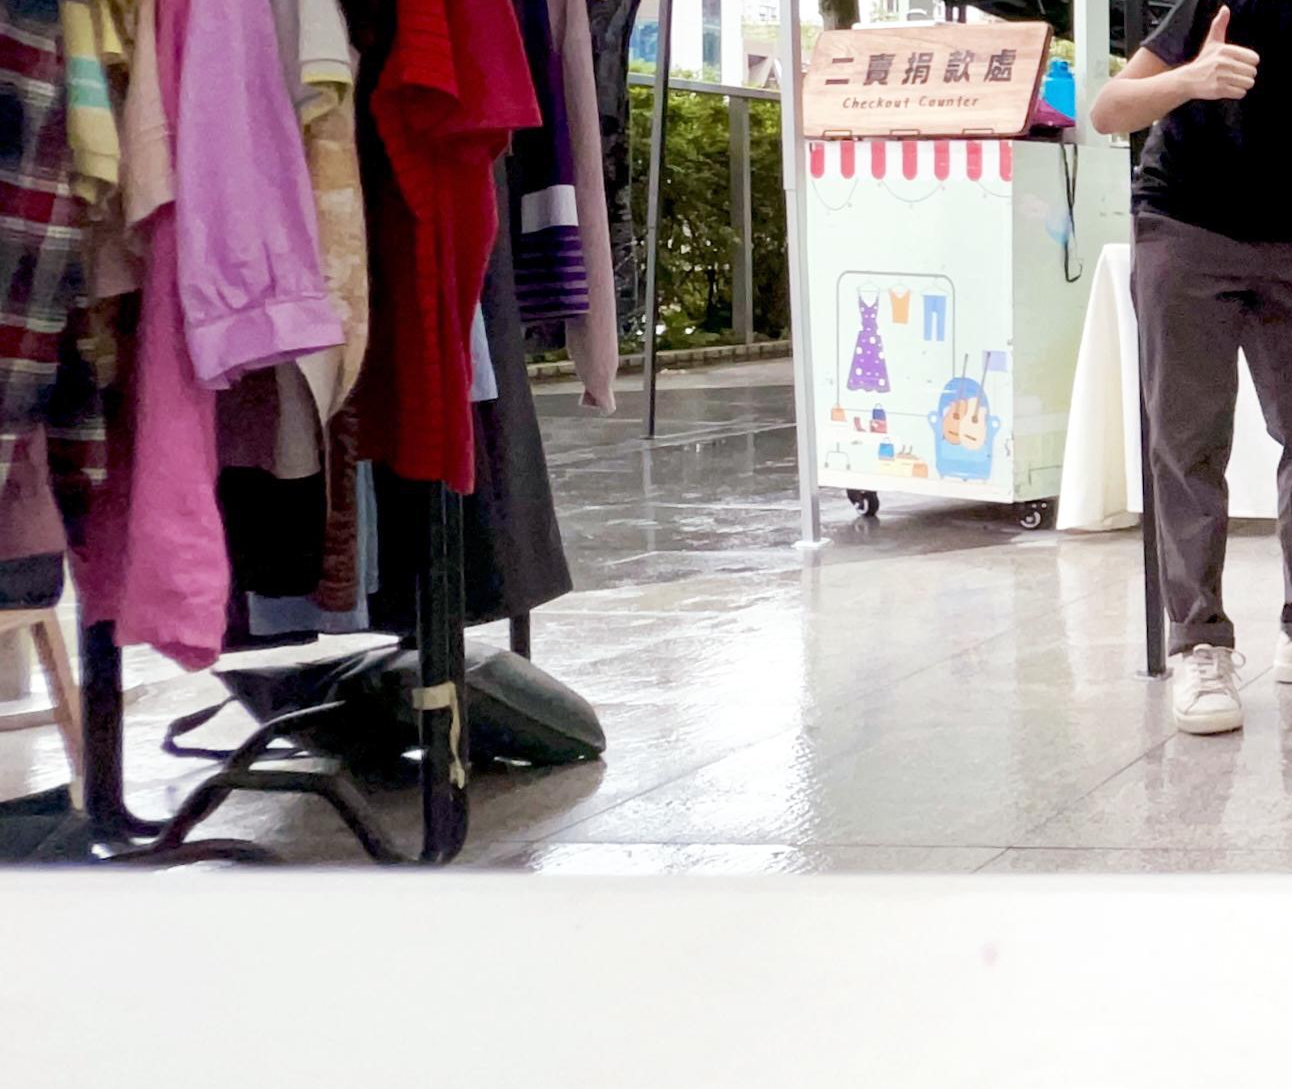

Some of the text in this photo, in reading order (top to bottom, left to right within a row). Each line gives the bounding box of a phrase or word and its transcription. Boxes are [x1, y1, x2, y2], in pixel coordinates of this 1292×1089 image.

[825, 49, 1017, 86] 二賣捐款處
[842, 95, 980, 110] Checkout Counter
